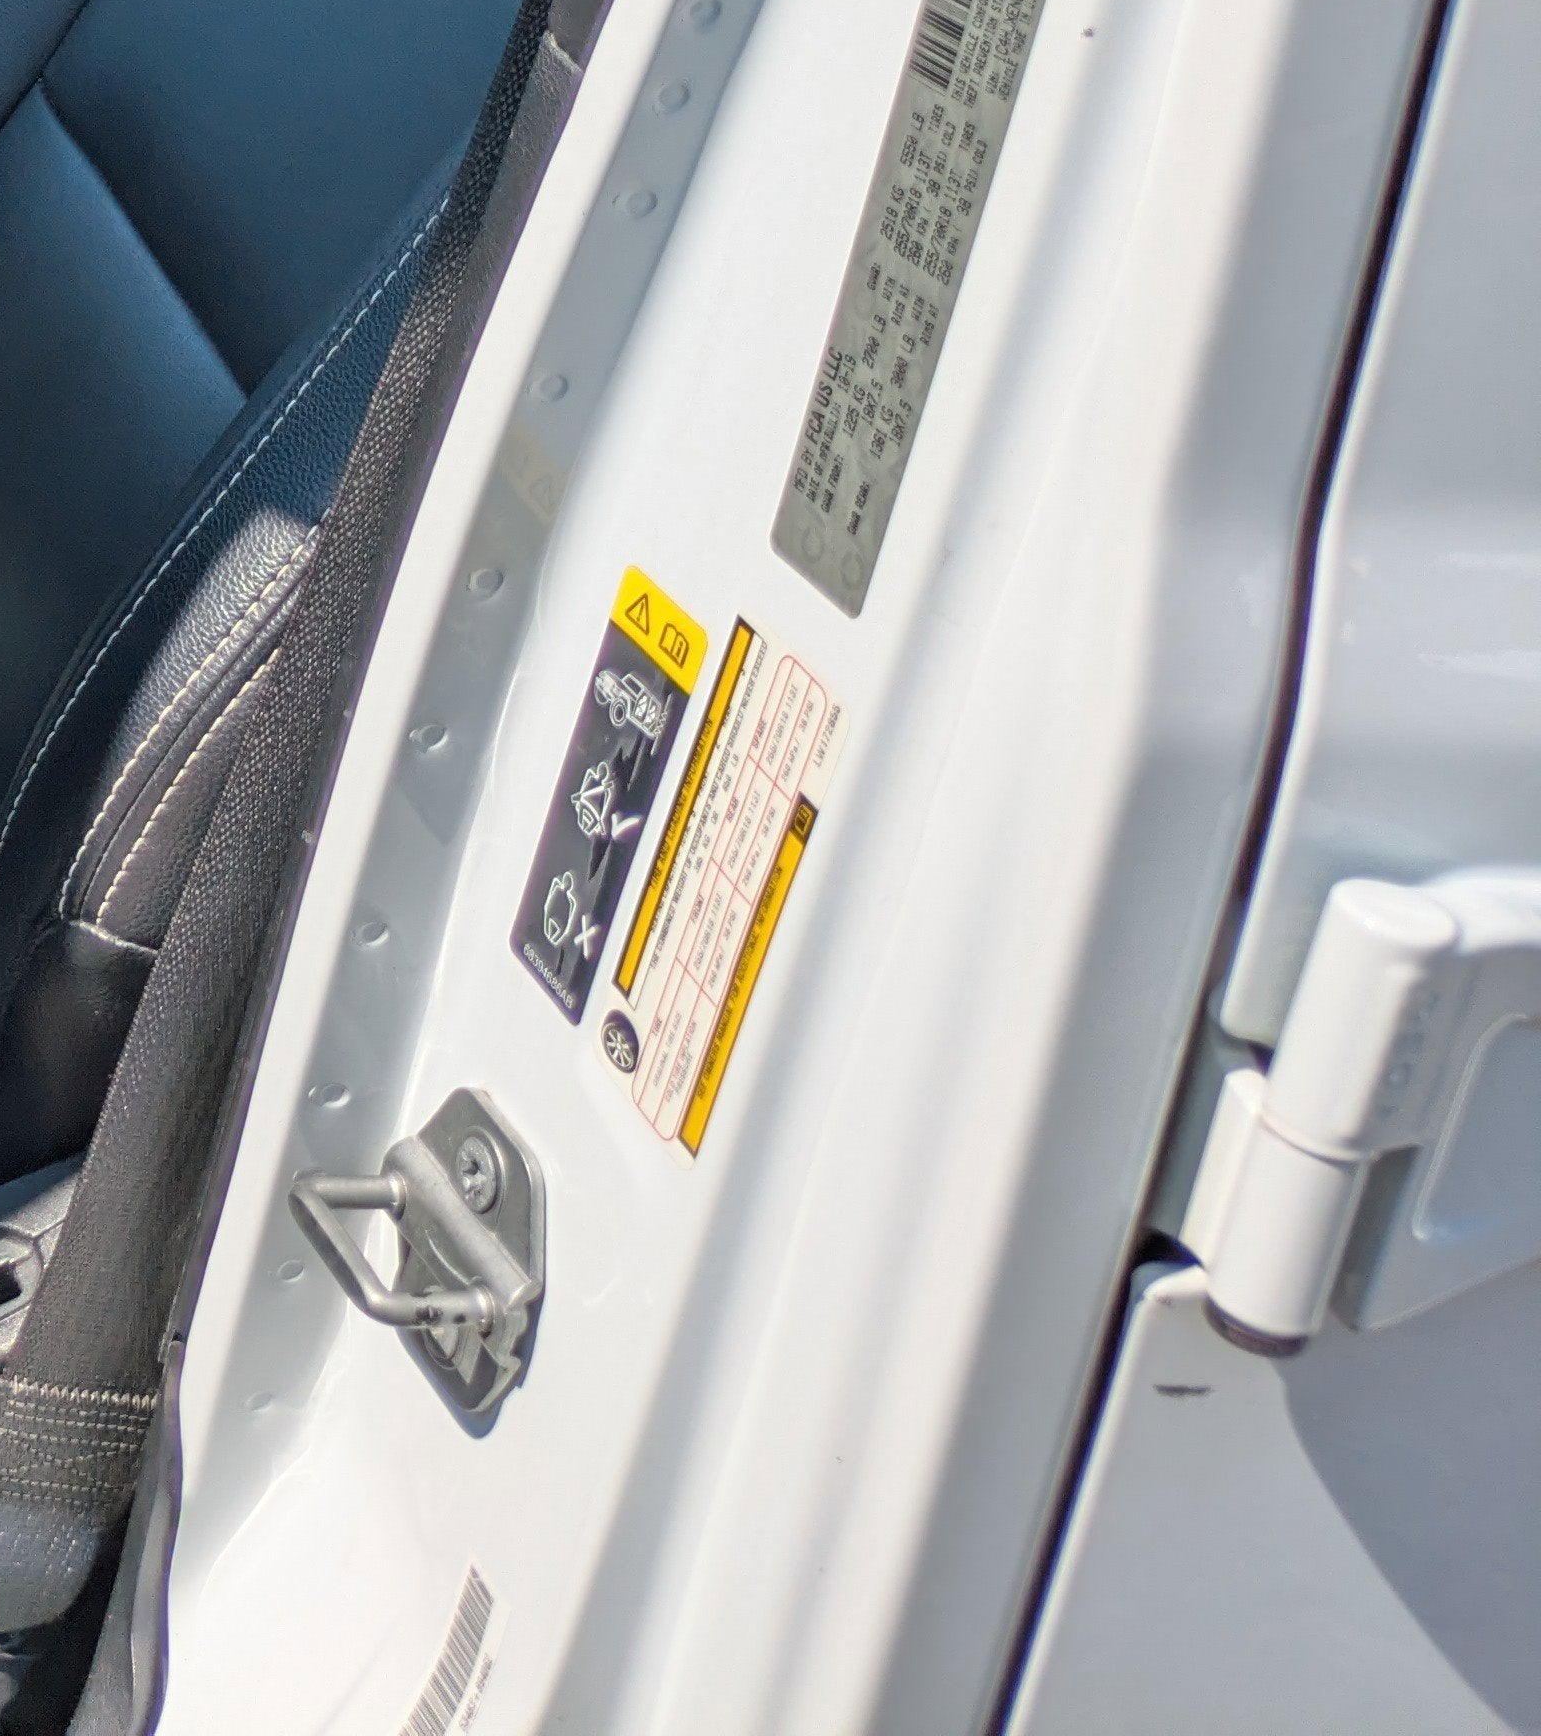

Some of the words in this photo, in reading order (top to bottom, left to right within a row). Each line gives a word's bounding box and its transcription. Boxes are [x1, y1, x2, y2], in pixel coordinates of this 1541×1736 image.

[957, 31, 979, 75] VEHICLE
[962, 77, 980, 110] THEFT
[971, 14, 998, 77] PREVENTION
[995, 57, 1018, 103] VEHICLE
[1009, 28, 1026, 56] MADE
[950, 75, 966, 102] THIS
[909, 110, 925, 132] LB
[926, 101, 945, 135] TIRES
[939, 119, 957, 148] COLD
[898, 133, 919, 169] 5550
[912, 149, 933, 184] 113T
[888, 182, 905, 205] KG
[925, 177, 941, 199] 38
[878, 204, 899, 241] 2518
[892, 185, 923, 258] 255/70R18
[905, 238, 924, 267] 260
[880, 274, 896, 302] WITH
[888, 396, 912, 447] 18X7.5
[918, 318, 935, 347] RIMS
[935, 257, 954, 286] 260
[955, 195, 972, 217] 38
[970, 137, 988, 166] COLD
[897, 282, 910, 299] AT
[845, 508, 861, 537] GAWR
[868, 425, 888, 460] 1361
[878, 403, 894, 426] KG
[888, 353, 909, 390] 3000
[899, 331, 916, 355] LB
[909, 293, 925, 322] WITH
[921, 203, 953, 277] 255/70R18
[942, 167, 963, 203] 113T
[957, 119, 976, 153] TIRES
[870, 312, 887, 334] LB
[889, 298, 906, 326] RIMS
[821, 344, 843, 382] LLC
[860, 333, 880, 370] 2700
[813, 378, 833, 410] US
[850, 382, 866, 405] KG
[860, 377, 883, 426] 18X7.5
[803, 406, 825, 446] FCA
[840, 403, 860, 439] 1225
[799, 445, 814, 467] BY
[812, 460, 824, 477] OF
[826, 451, 845, 489] FRONT:
[791, 464, 809, 495] MFD
[805, 475, 820, 504] DATE
[819, 486, 834, 515] GAWR
[648, 862, 662, 893] TIRE
[657, 837, 670, 867] AND
[665, 790, 687, 843] LOADING
[682, 714, 713, 796] INFORMATION
[655, 902, 676, 955] COMBINED
[671, 867, 688, 908] WEIGHT
[689, 799, 712, 858] OCCUPANTS
[708, 780, 719, 803] AND
[715, 746, 731, 783] CARGO
[727, 709, 744, 749] SHOULD
[740, 677, 755, 711] NEVER
[751, 639, 769, 679] EXCEED
[690, 890, 705, 927] FRONT
[725, 794, 739, 824] REAR
[751, 716, 767, 750] SPARE
[755, 861, 783, 932] INFORMATION
